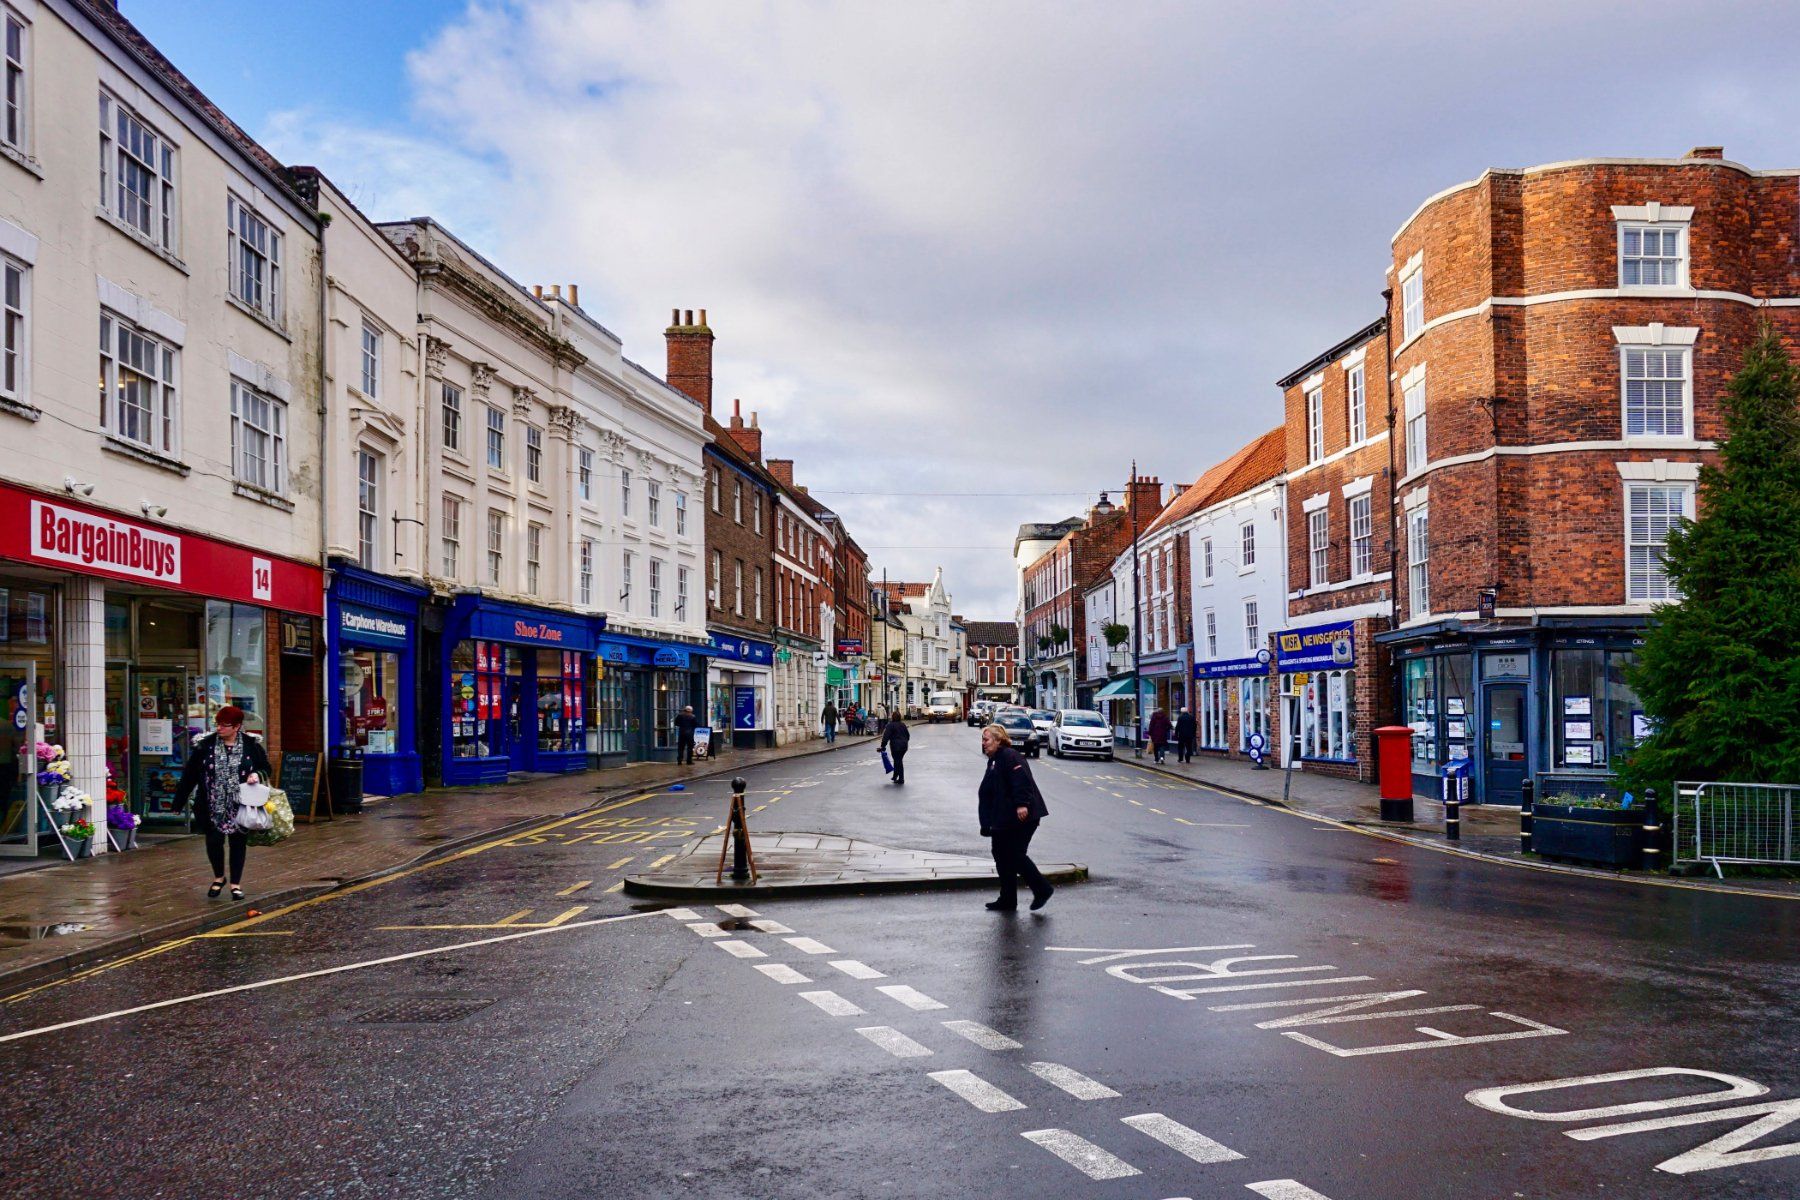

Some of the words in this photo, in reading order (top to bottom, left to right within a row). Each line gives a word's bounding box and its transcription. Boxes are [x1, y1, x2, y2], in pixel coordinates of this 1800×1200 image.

[41, 505, 175, 577] BargainBuys
[255, 568, 269, 591] 14
[346, 613, 375, 631] Carphone
[376, 619, 406, 636] Warehouse
[515, 621, 537, 638] Shoe
[539, 624, 562, 641] Zone
[1284, 636, 1298, 650] MSR
[1302, 629, 1351, 647] NEWSGROUP
[609, 652, 623, 661] NERO
[1293, 686, 1301, 695] H
[576, 816, 714, 829] BUS
[502, 831, 695, 847] STOP
[1044, 944, 1570, 1057] ENTRY
[1464, 1067, 1800, 1174] NO
